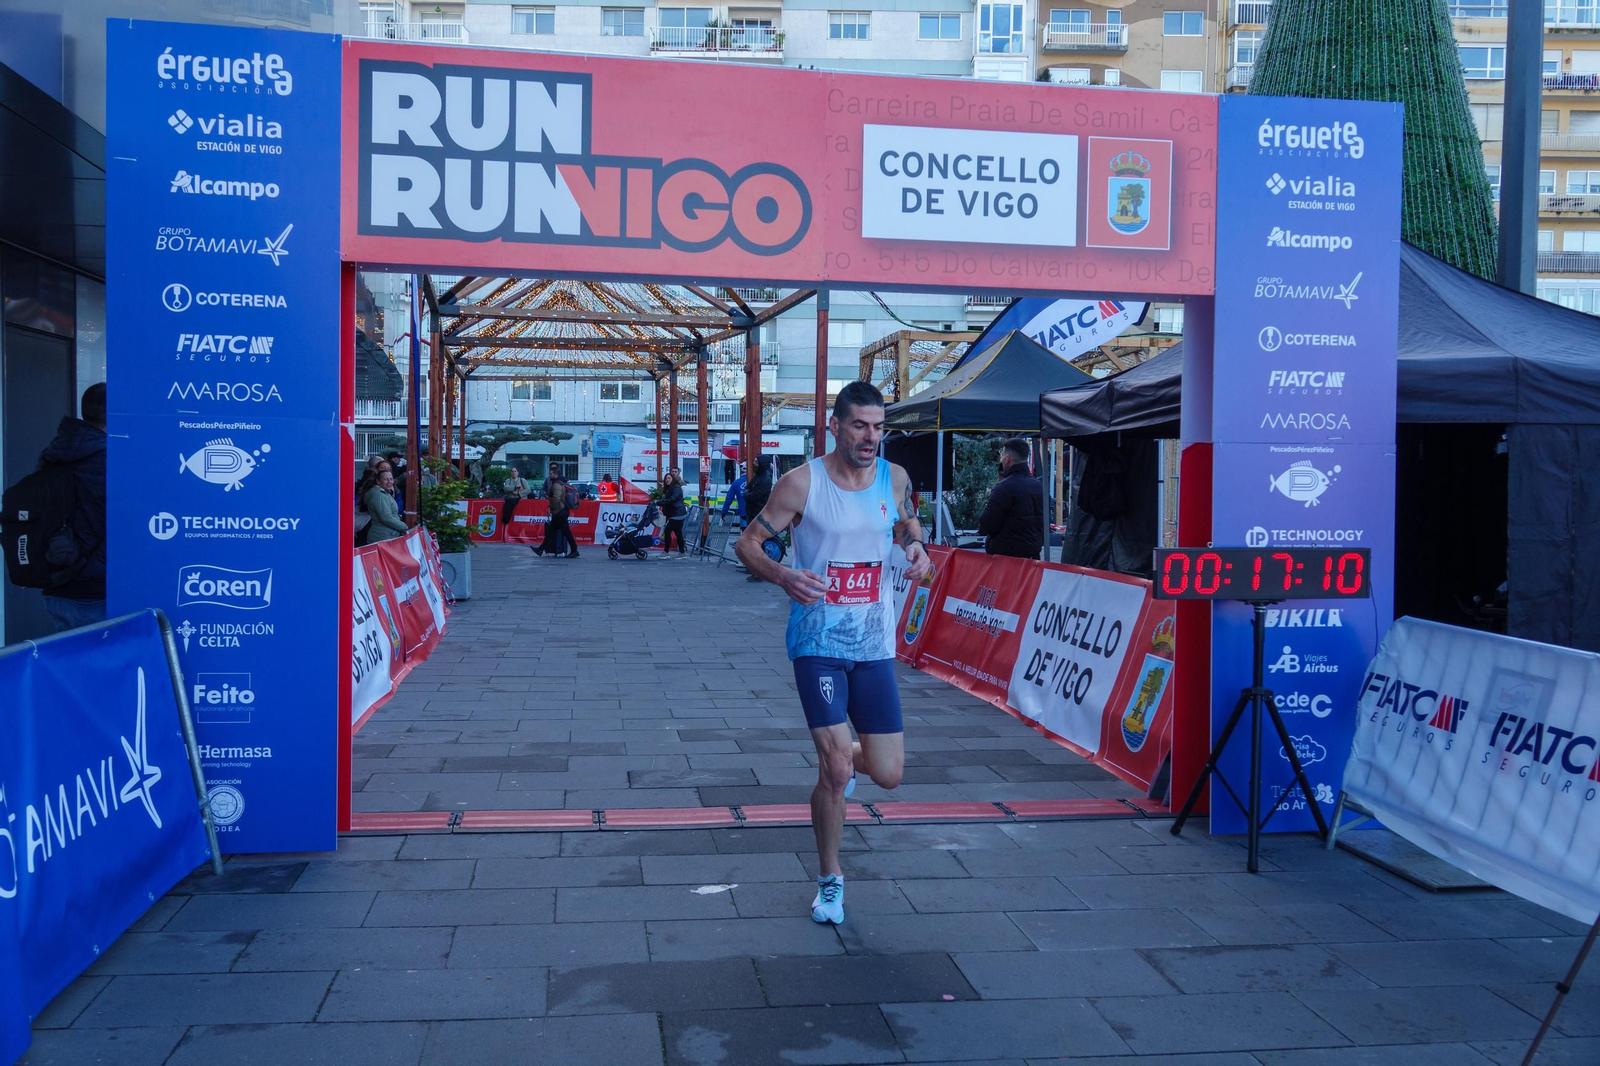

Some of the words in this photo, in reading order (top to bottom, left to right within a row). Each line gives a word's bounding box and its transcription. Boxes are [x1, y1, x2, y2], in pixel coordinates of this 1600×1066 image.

[371, 71, 584, 156] RUN
[826, 88, 938, 120] Carreira
[949, 95, 1018, 124] Praia
[1028, 100, 1064, 127] De
[1073, 102, 1145, 130] Samil
[197, 113, 283, 139] vialia
[196, 141, 241, 153] ESTACIÓN
[244, 144, 257, 154] DE
[259, 145, 283, 155] VIGO
[878, 149, 1061, 185] CONCELLO
[170, 170, 280, 201] Alcampo
[1289, 175, 1355, 197] vialia
[900, 187, 945, 215] DE
[957, 189, 1039, 220] VIGO
[1288, 200, 1322, 210] ESTACIÓN
[1325, 202, 1335, 211] DE
[1337, 202, 1355, 211] VIGO
[158, 227, 191, 236] GRUPO
[1267, 227, 1353, 252] Alcampo
[155, 235, 258, 254] BOTAMAVI
[878, 249, 931, 273] 5+5
[943, 249, 978, 275] Do
[989, 251, 1098, 279] Calvario
[1124, 257, 1166, 282] 10k
[1177, 258, 1211, 283] De
[195, 292, 288, 308] COTERENA
[1254, 285, 1334, 299] BOTAMAVI
[1060, 313, 1129, 352] GUROS
[1284, 334, 1357, 346] COTERENA
[175, 353, 271, 363] SEGUROS
[167, 381, 283, 402] MAROSA
[1260, 413, 1351, 430] MAROSA
[182, 515, 301, 531] TECHNOLOGY
[1271, 529, 1364, 541] TECHNOLOGY
[846, 573, 872, 590] 641
[1162, 553, 1364, 594] 00:17:10
[838, 595, 871, 604] Alcampo
[1264, 608, 1343, 627] BIKILA
[200, 621, 275, 635] FUNDACIÓN
[1033, 600, 1123, 658] CONCELLO
[199, 636, 241, 648] CELTA
[1303, 654, 1328, 662] Viajes
[1023, 648, 1052, 687] DE
[1050, 658, 1093, 705] VIGO
[1303, 663, 1339, 673] Airbus
[193, 683, 255, 704] Feito
[1369, 712, 1454, 751] EGUROS
[197, 745, 273, 759] Hermasa
[1270, 785, 1318, 798] Teato
[1292, 800, 1306, 810] Ar
